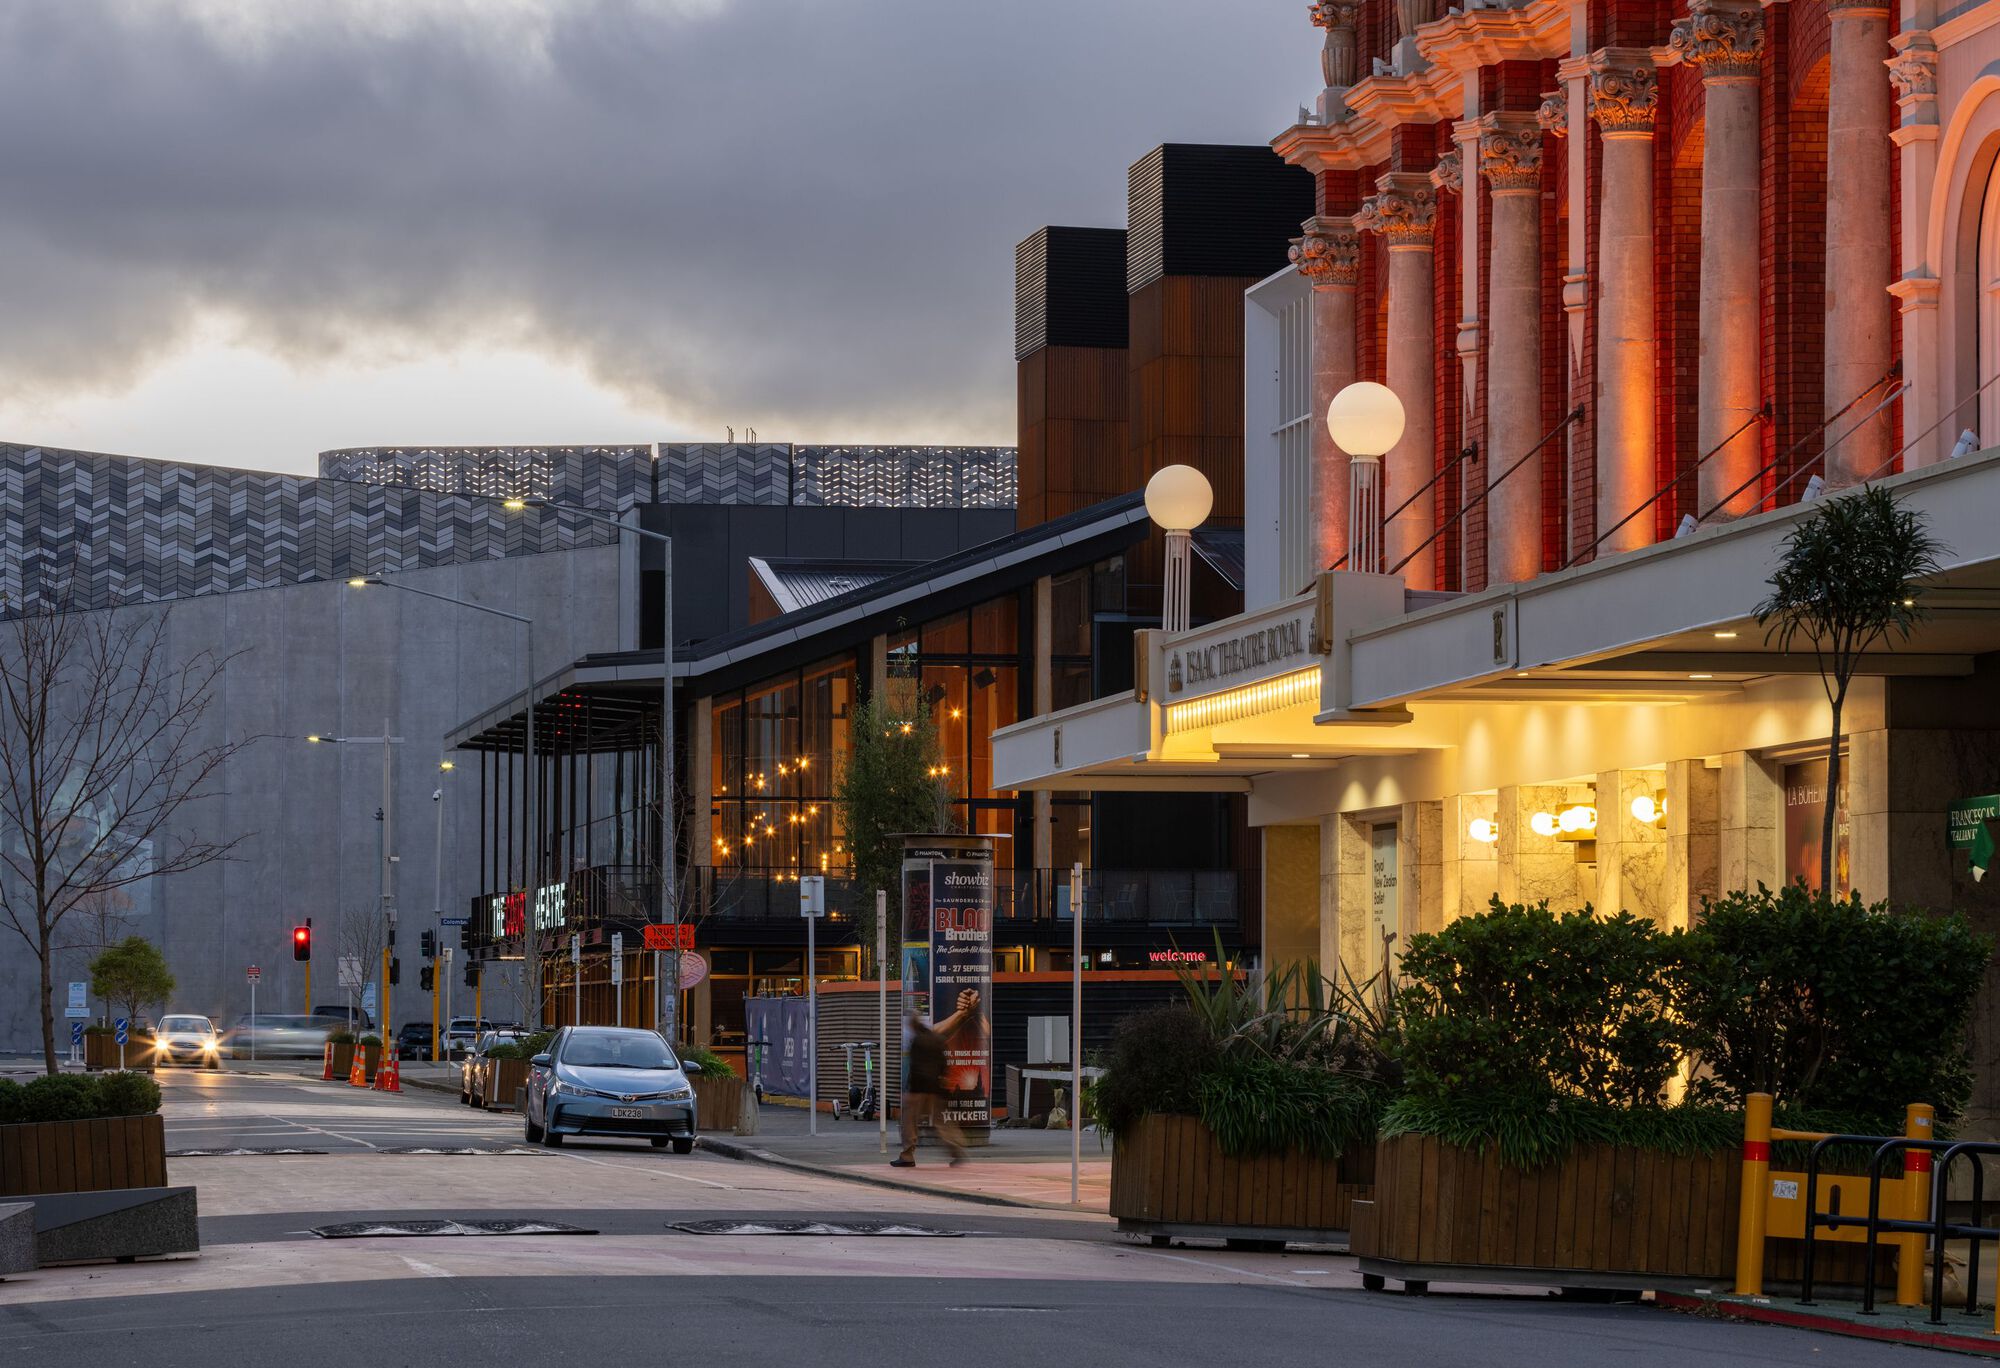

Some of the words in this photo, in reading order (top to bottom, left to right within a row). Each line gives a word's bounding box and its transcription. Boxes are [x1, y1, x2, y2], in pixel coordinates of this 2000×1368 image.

[1186, 645, 1217, 684] ISAAC
[1217, 630, 1267, 676] THEATRE
[1267, 619, 1304, 662] ROYAL
[1788, 786, 1797, 806] LA
[944, 872, 989, 886] showbiz
[492, 896, 505, 938] THE
[535, 882, 566, 931] HEATRE
[648, 938, 692, 947] CROSSNG
[1149, 949, 1206, 962] welcome
[952, 964, 961, 972] 27
[612, 1109, 642, 1118] LDK238
[952, 1110, 989, 1121] TICKETEK
